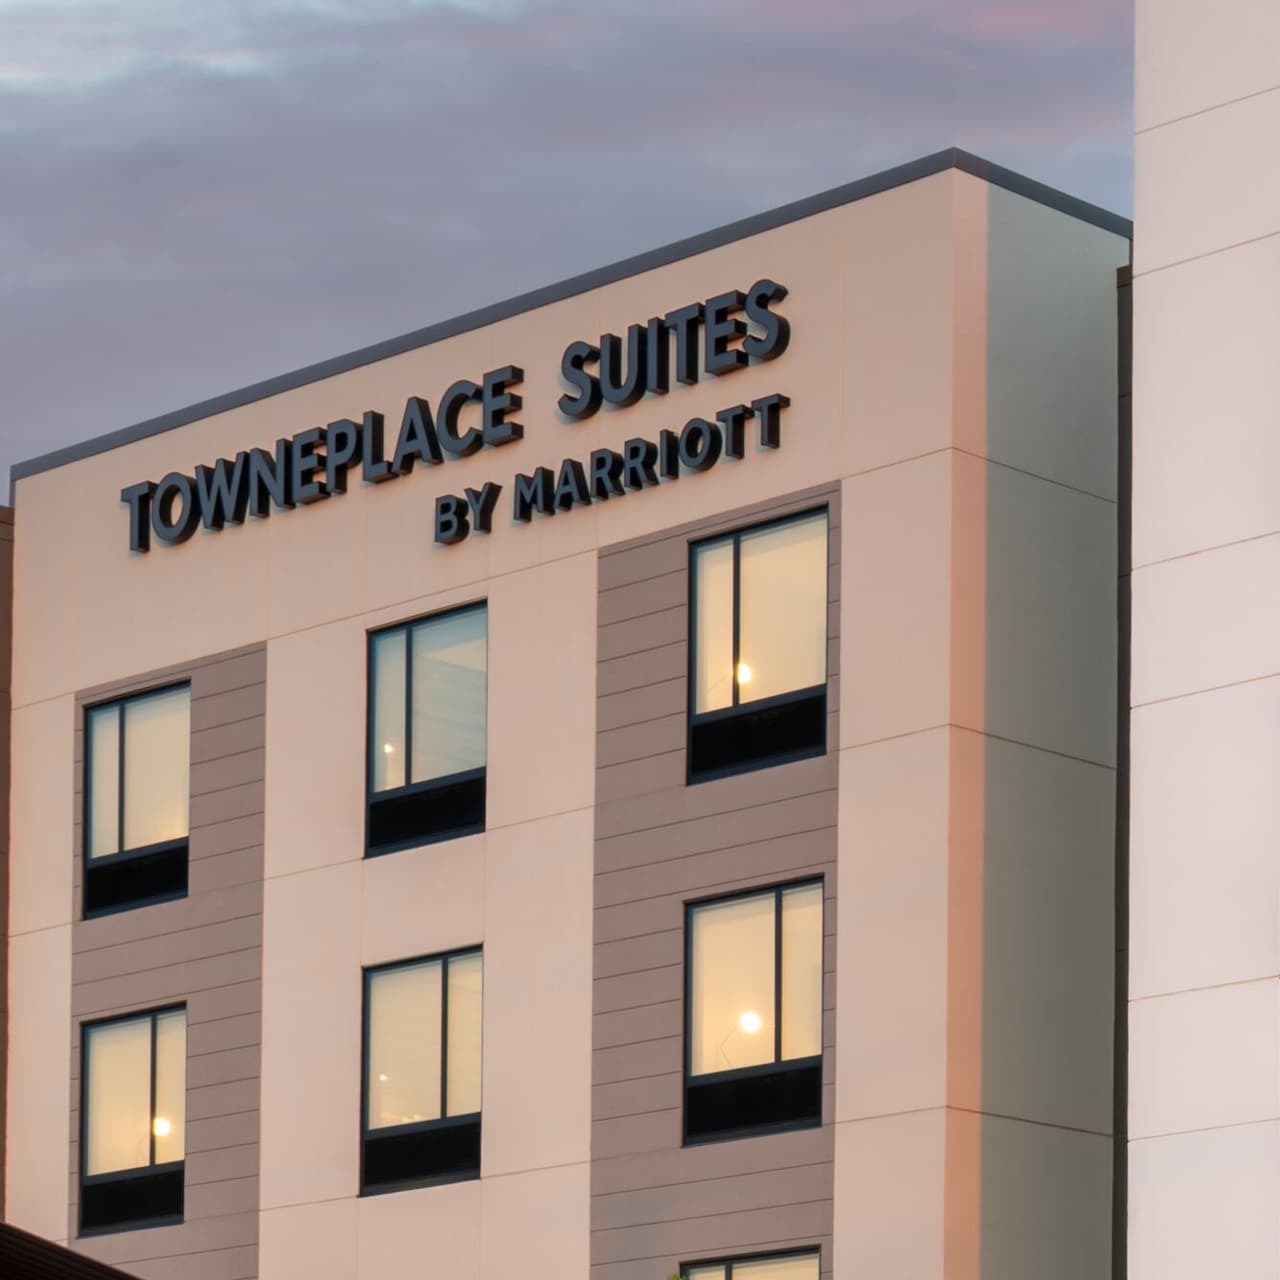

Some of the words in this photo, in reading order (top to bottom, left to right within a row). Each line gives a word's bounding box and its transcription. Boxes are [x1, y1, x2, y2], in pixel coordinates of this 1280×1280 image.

[121, 365, 525, 552] TOWNEPLACE
[557, 279, 790, 420] SUITES
[434, 482, 502, 544] BY
[513, 393, 791, 521] MARRIOTT
